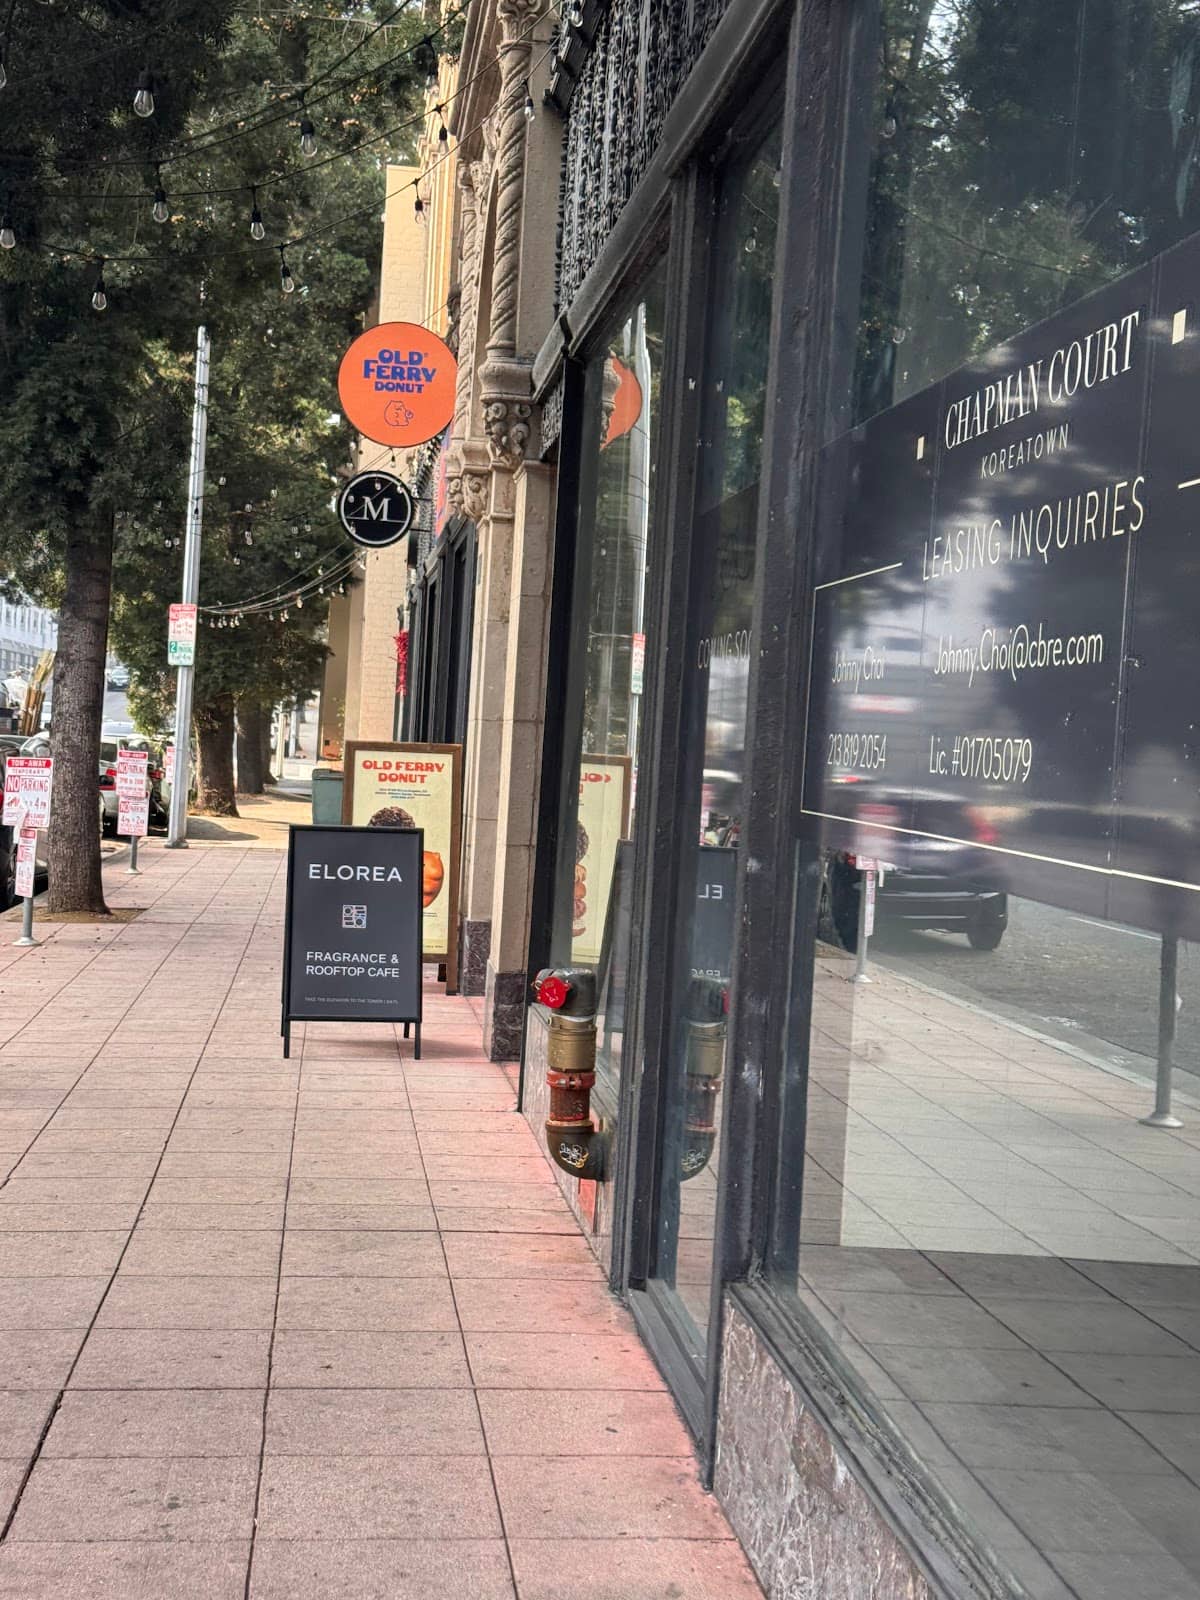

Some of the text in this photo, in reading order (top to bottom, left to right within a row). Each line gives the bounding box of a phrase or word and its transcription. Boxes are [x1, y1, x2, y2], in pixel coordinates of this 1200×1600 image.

[378, 349, 423, 365] OLD
[363, 359, 436, 382] FERRY
[945, 311, 1139, 449] CHAPMAN COURT
[374, 381, 424, 393] DONUT
[980, 423, 1069, 479] KOREATOWN
[362, 496, 391, 520] M
[922, 476, 1145, 581] LEASING INQUIRIES
[934, 623, 1103, 688] Johnny.Choi@cbre.com
[832, 645, 886, 693] Johnny Choi
[827, 734, 842, 765] 213
[860, 734, 887, 769] 2054
[929, 736, 1032, 783] Lic. #01705079
[12, 759, 46, 767] TOW-AWAY
[362, 760, 445, 773] OLD FERRY
[7, 776, 48, 792] NO PARKING
[378, 773, 427, 784] DONUT
[308, 863, 403, 882] ELOREA
[306, 951, 399, 964] FRAGRANCE &
[306, 965, 400, 978] ROOFTOP CAFE
